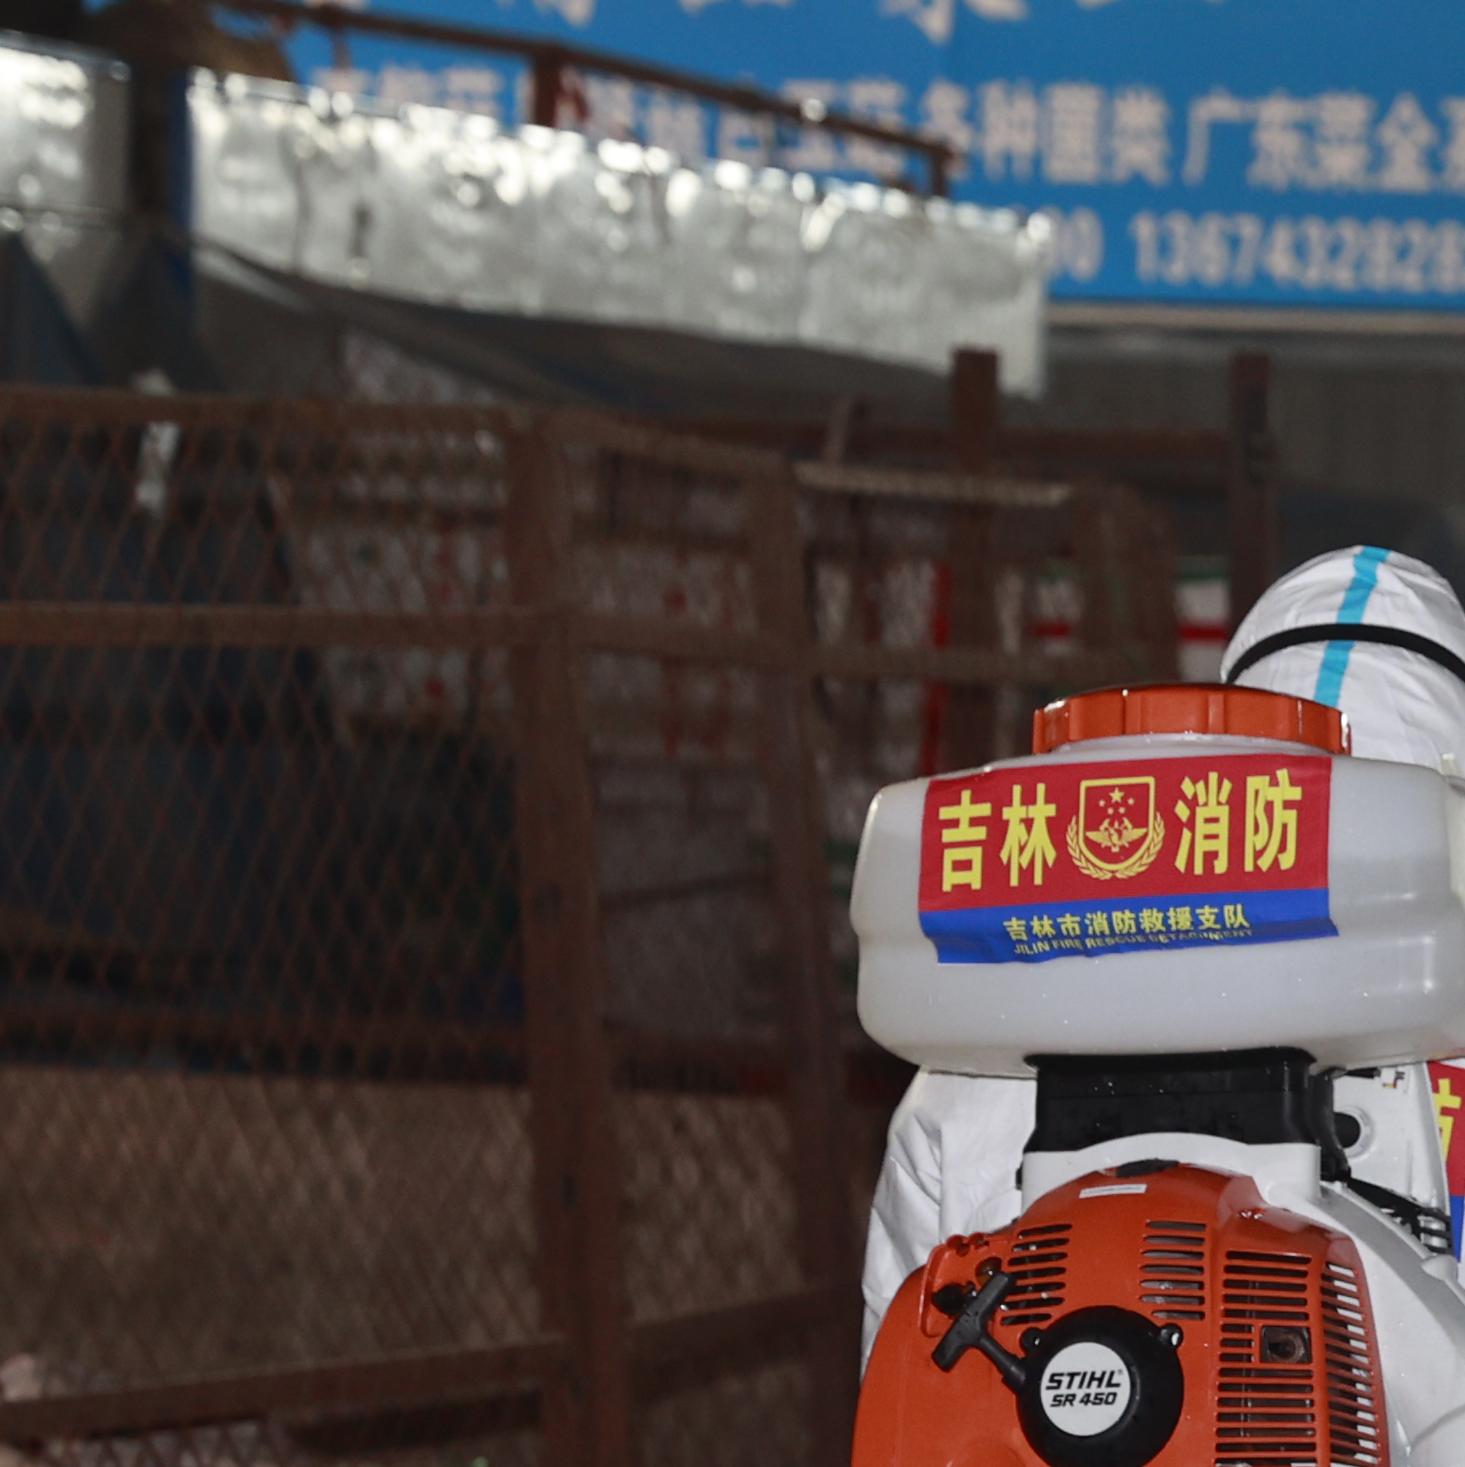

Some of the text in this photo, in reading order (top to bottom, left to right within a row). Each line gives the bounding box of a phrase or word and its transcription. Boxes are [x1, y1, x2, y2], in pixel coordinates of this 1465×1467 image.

[938, 768, 1303, 892] 吉林 消防
[1002, 903, 1250, 941] 吉林市消防救援支队
[1014, 940, 1051, 955] JILIN
[1045, 1369, 1122, 1391] STIHL
[1049, 1391, 1118, 1408] SR 450
